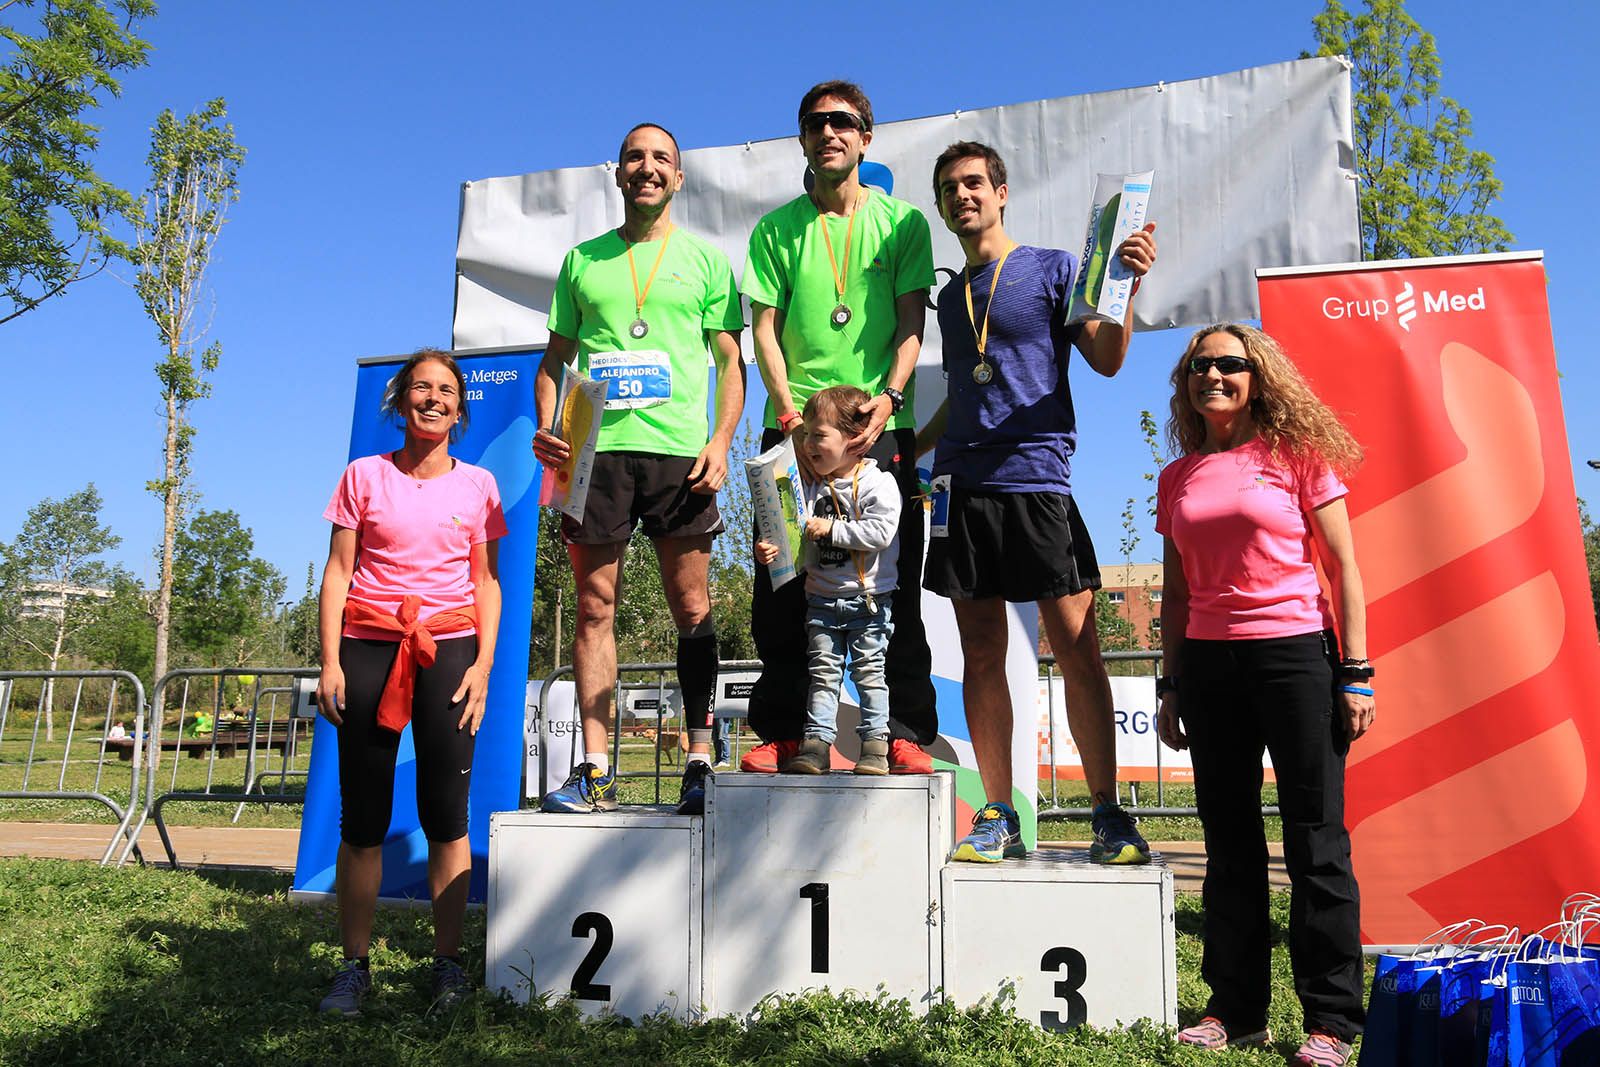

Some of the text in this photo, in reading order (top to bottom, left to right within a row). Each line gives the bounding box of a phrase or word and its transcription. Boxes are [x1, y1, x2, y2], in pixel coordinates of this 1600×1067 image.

[1322, 287, 1486, 321] Grup Med
[470, 369, 518, 384] Metges
[601, 367, 660, 378] ALEJANDRO
[465, 389, 484, 400] na
[618, 380, 643, 397] 50
[527, 718, 583, 738] Mtges
[529, 744, 539, 757] a
[800, 883, 829, 974] 1
[570, 912, 614, 1002] 2
[1040, 947, 1088, 1031] 3
